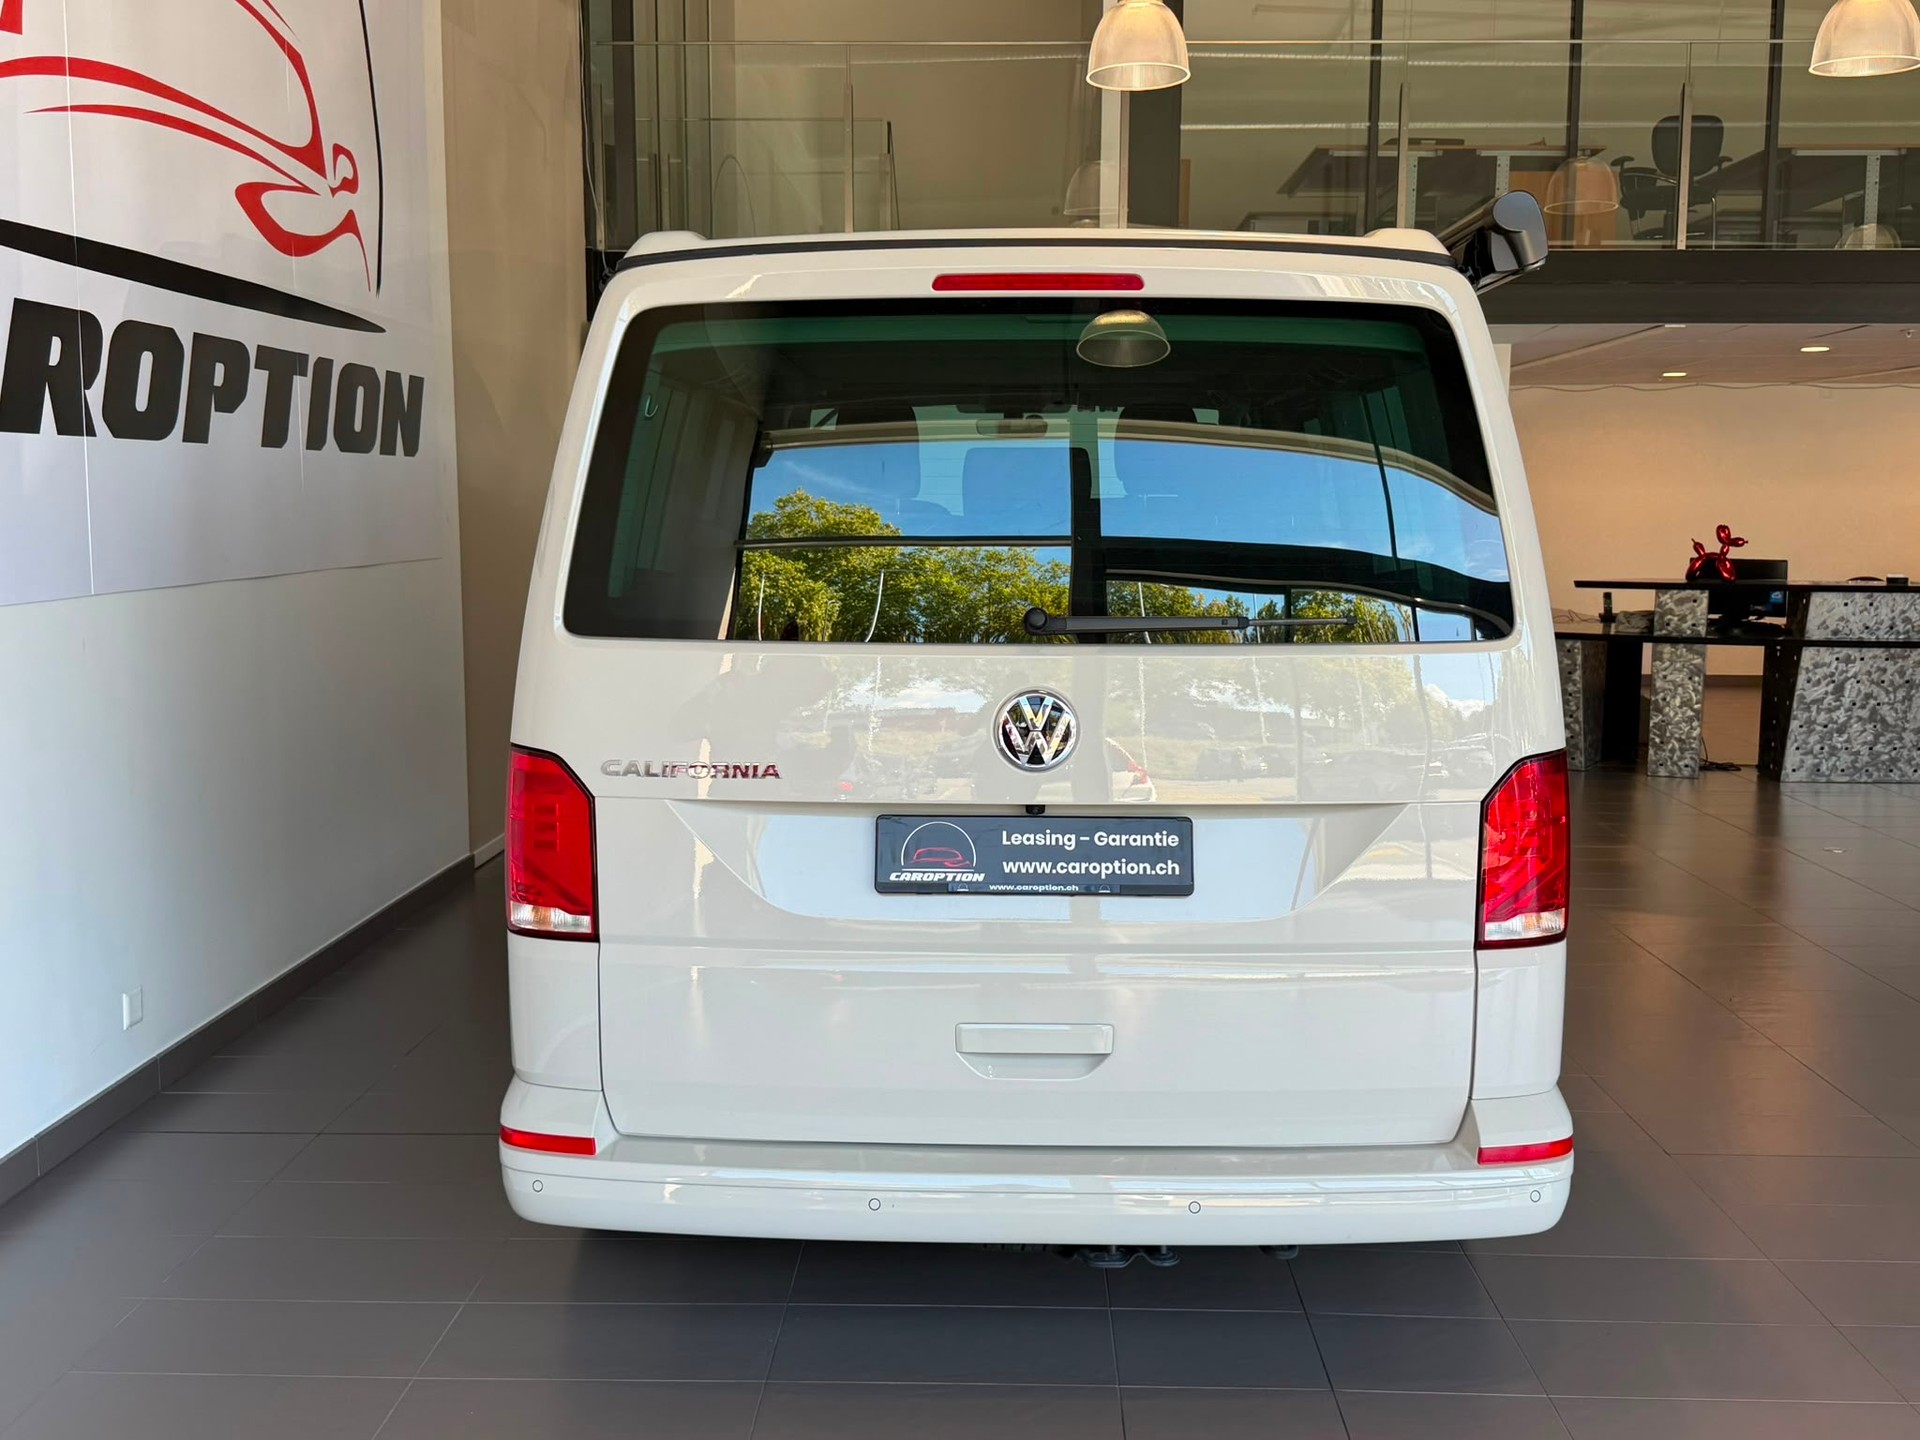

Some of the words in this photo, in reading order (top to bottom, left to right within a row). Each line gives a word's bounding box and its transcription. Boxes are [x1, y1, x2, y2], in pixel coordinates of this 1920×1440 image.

[0, 297, 425, 458] ROPTION
[600, 759, 782, 779] CALIFORNIA
[1002, 830, 1076, 850] Leasing
[1094, 831, 1180, 847] Garantie
[889, 872, 985, 882] CAROPTION
[1002, 859, 1180, 879] www.caroption.ch
[989, 884, 1079, 892] www.caroption.ch
